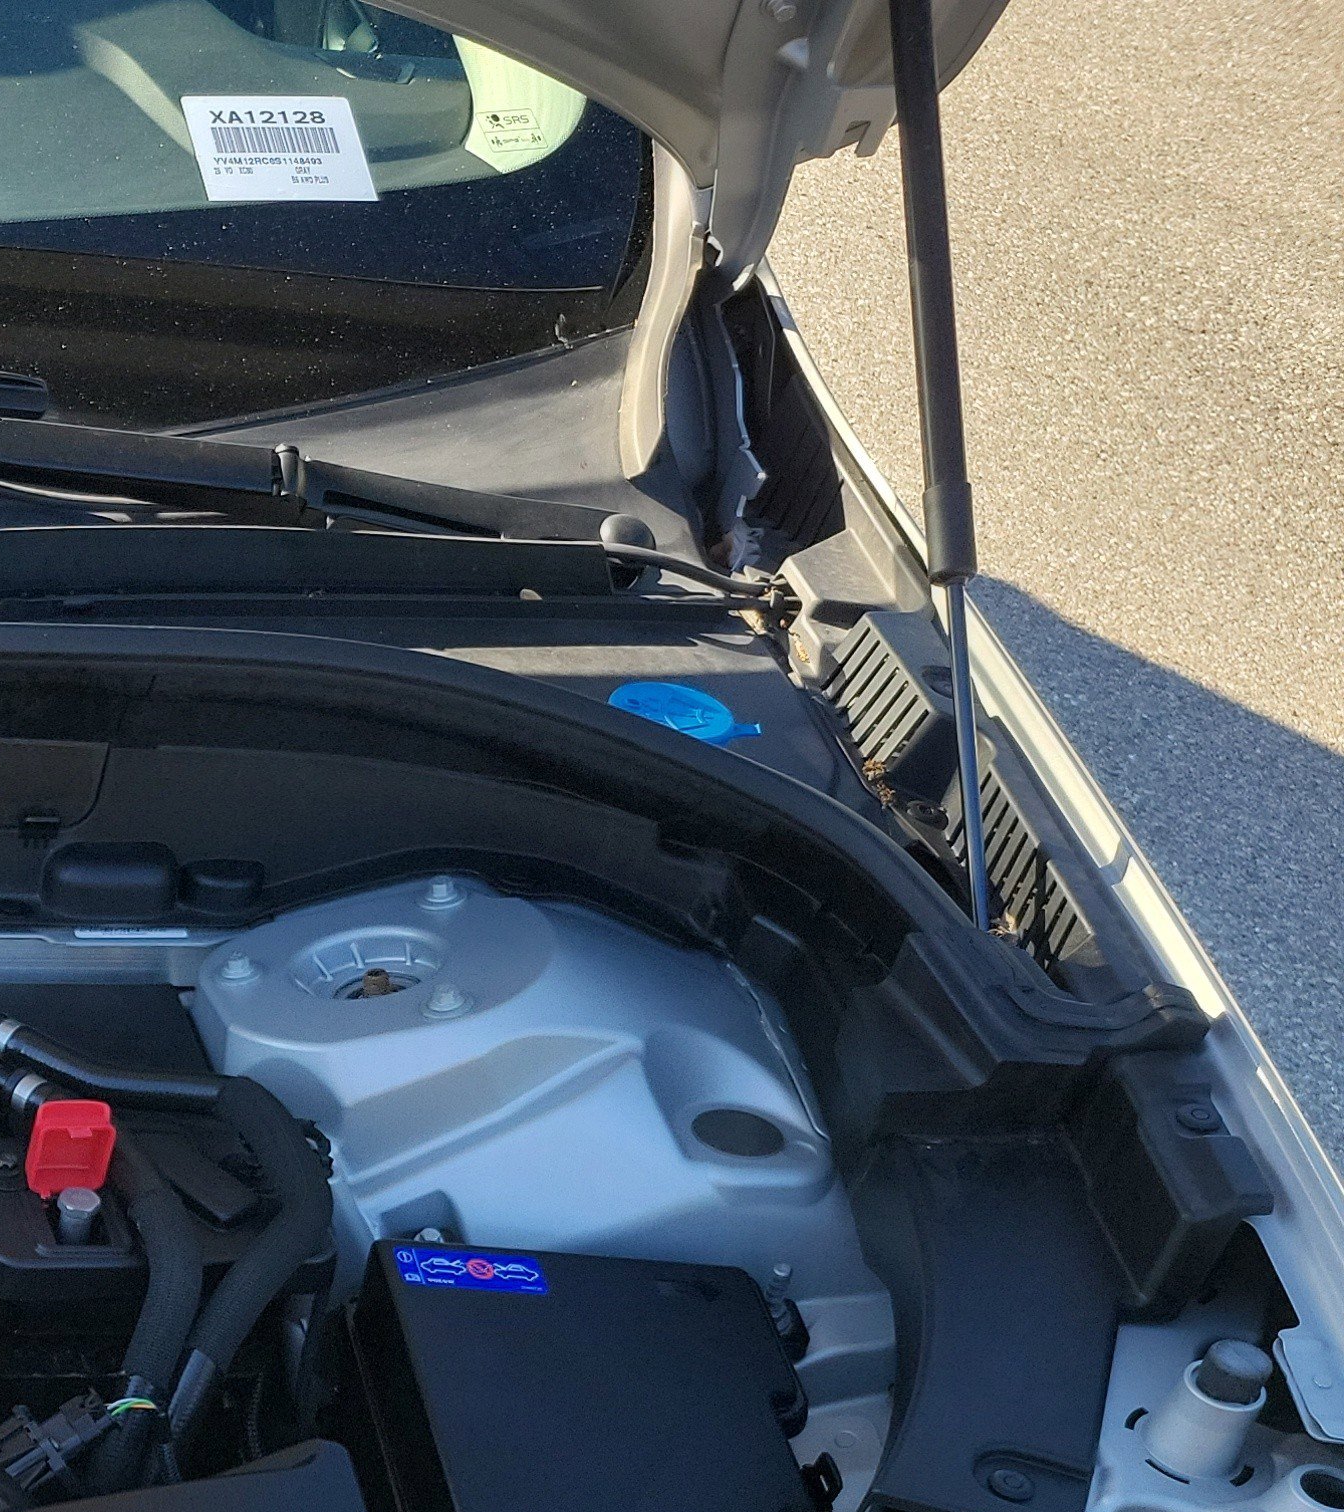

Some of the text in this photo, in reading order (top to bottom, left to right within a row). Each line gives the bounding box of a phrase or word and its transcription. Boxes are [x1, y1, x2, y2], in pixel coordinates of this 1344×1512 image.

[209, 110, 326, 124] XA12128
[503, 114, 530, 125] SRS
[295, 166, 310, 175] GRAY
